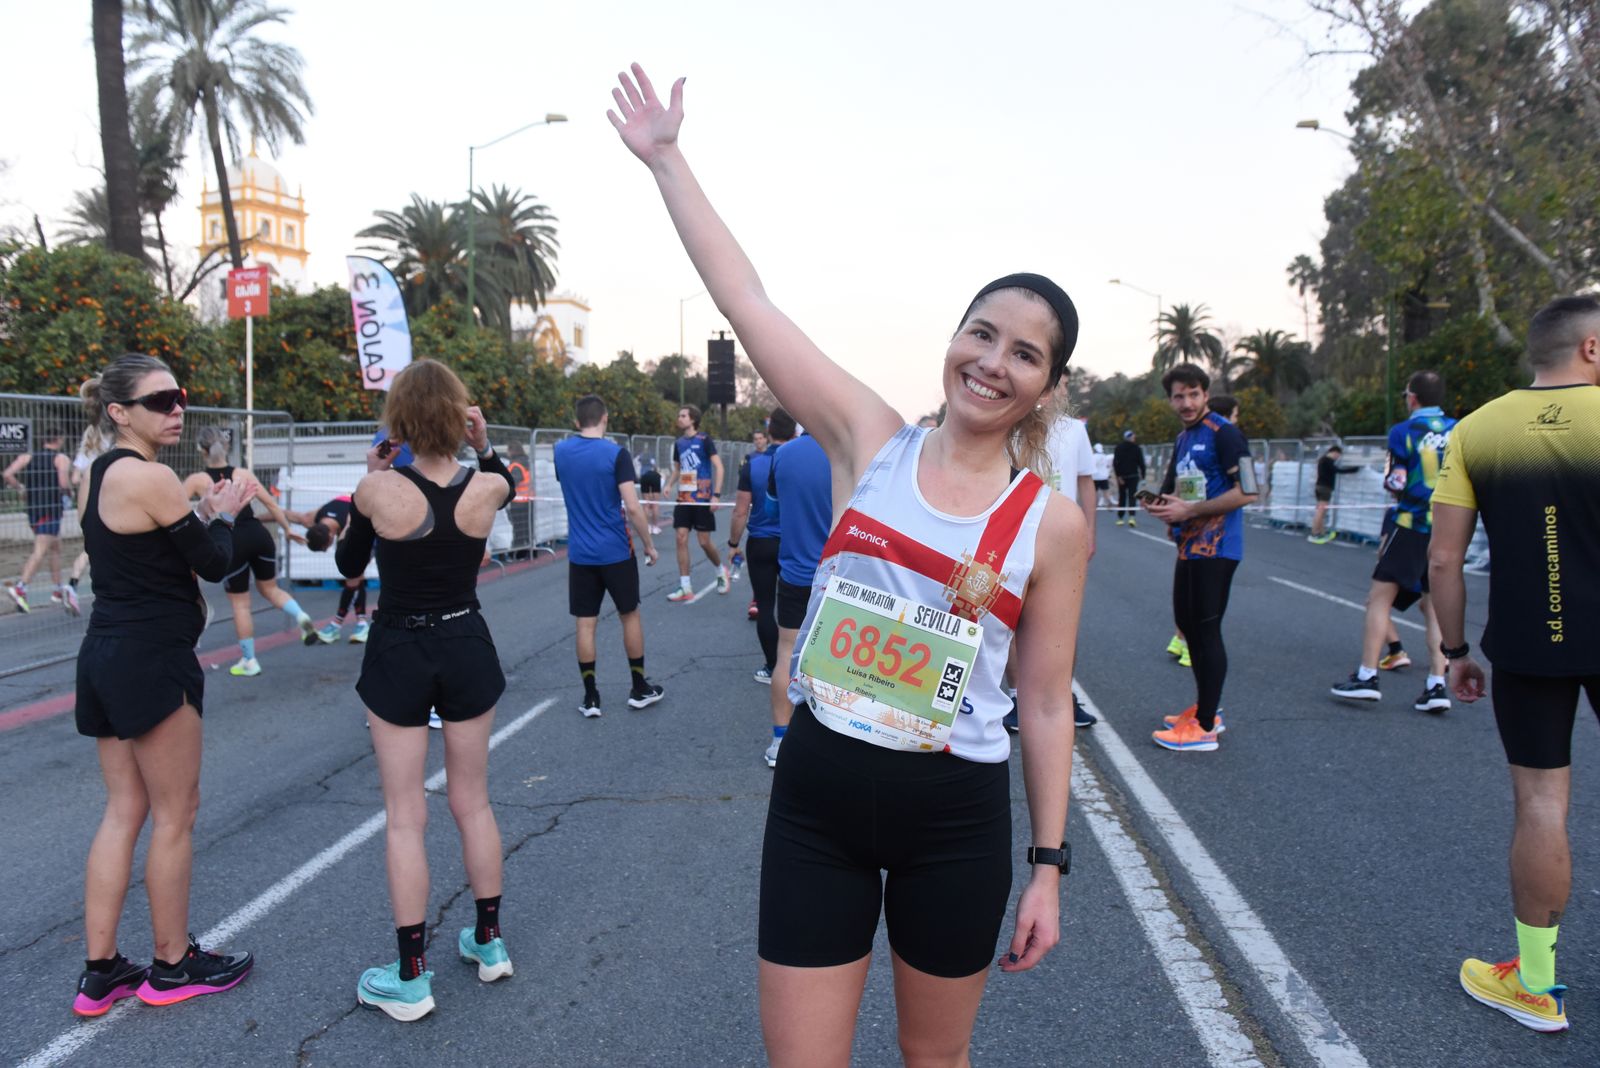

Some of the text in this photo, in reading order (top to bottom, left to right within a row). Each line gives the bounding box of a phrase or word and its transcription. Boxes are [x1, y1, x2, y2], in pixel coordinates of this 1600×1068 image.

[1543, 505, 1562, 612] correcaminos
[836, 581, 961, 637] MEDIO MARATÓN SEVILLA
[830, 618, 932, 688] 6852
[868, 673, 896, 689] Ribeiro
[848, 719, 873, 734] HOKA
[1515, 992, 1549, 1008] HOKA
